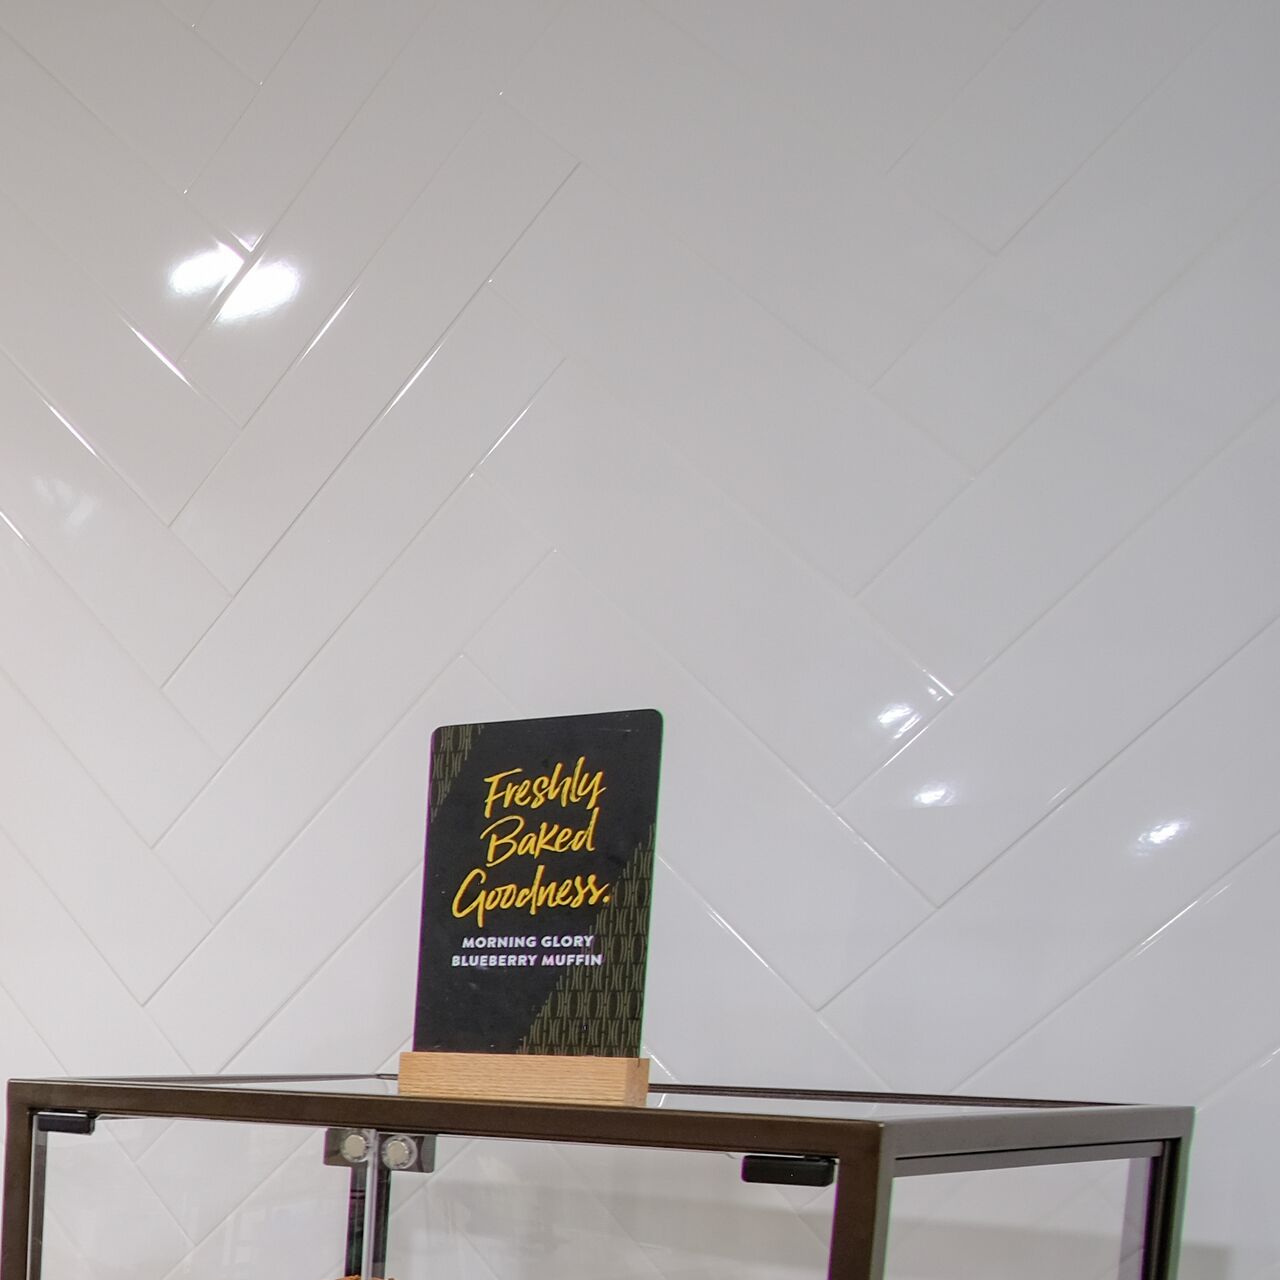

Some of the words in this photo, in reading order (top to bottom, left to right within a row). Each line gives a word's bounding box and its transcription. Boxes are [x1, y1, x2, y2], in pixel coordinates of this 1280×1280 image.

[483, 756, 607, 818] Freshly
[480, 807, 600, 867] Baked
[451, 865, 611, 928] Goodness.
[451, 954, 537, 967] BLUEBERRY
[541, 953, 603, 967] MUFFIN
[462, 935, 537, 949] MORNING
[541, 935, 594, 948] GLORY
